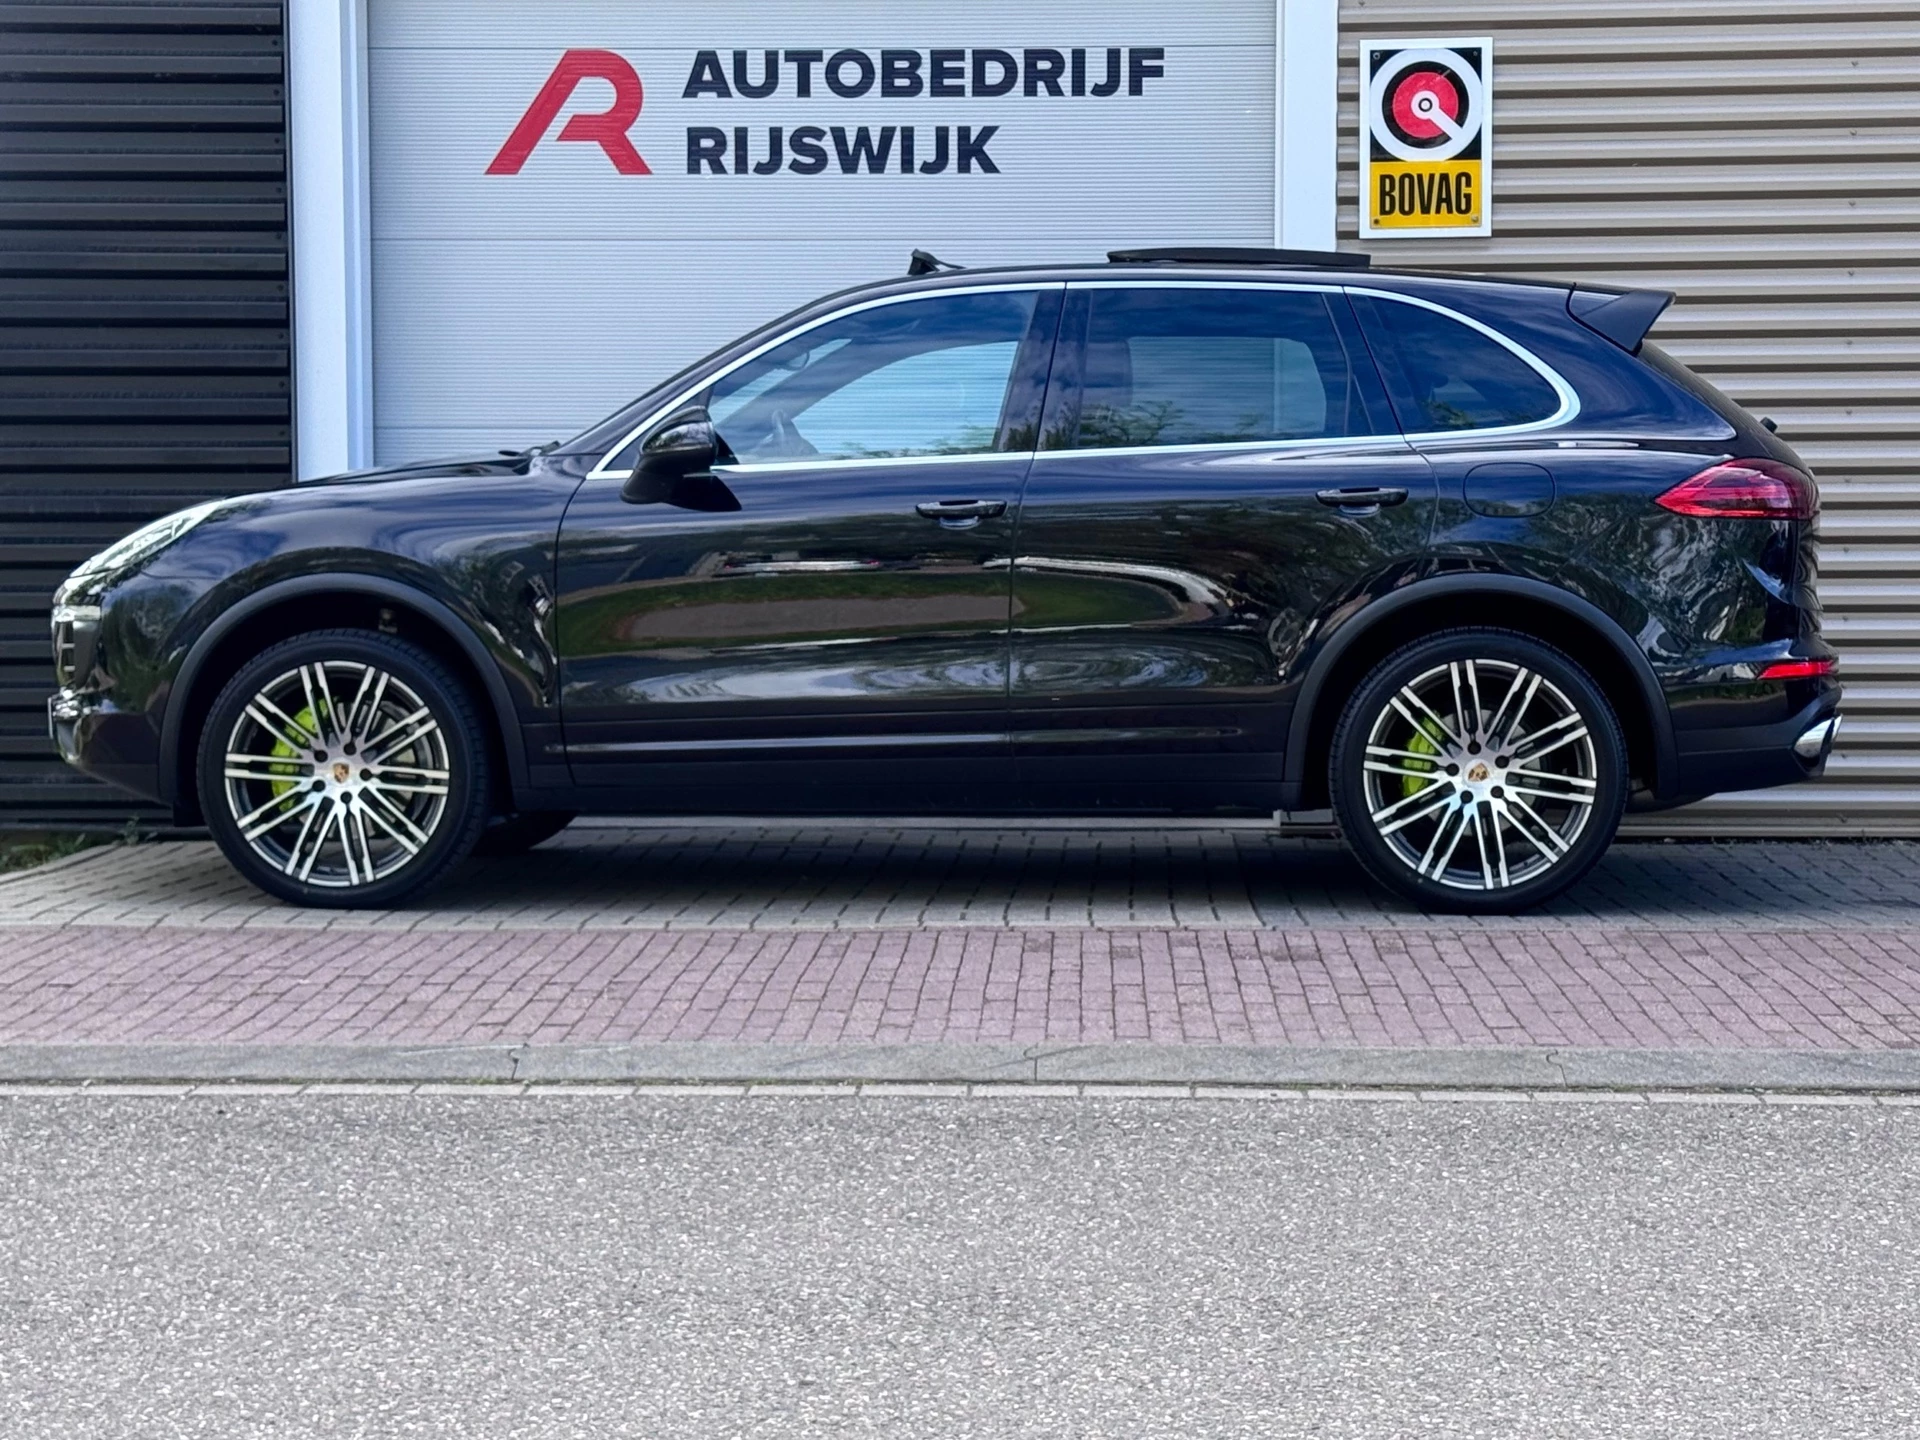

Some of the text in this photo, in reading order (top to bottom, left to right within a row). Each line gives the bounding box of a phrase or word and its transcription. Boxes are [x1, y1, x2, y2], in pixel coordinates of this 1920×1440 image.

[682, 47, 1165, 98] AUTOBEDRIJF
[686, 126, 1001, 175] RIJSWIJK
[1379, 172, 1472, 216] BOVAG
